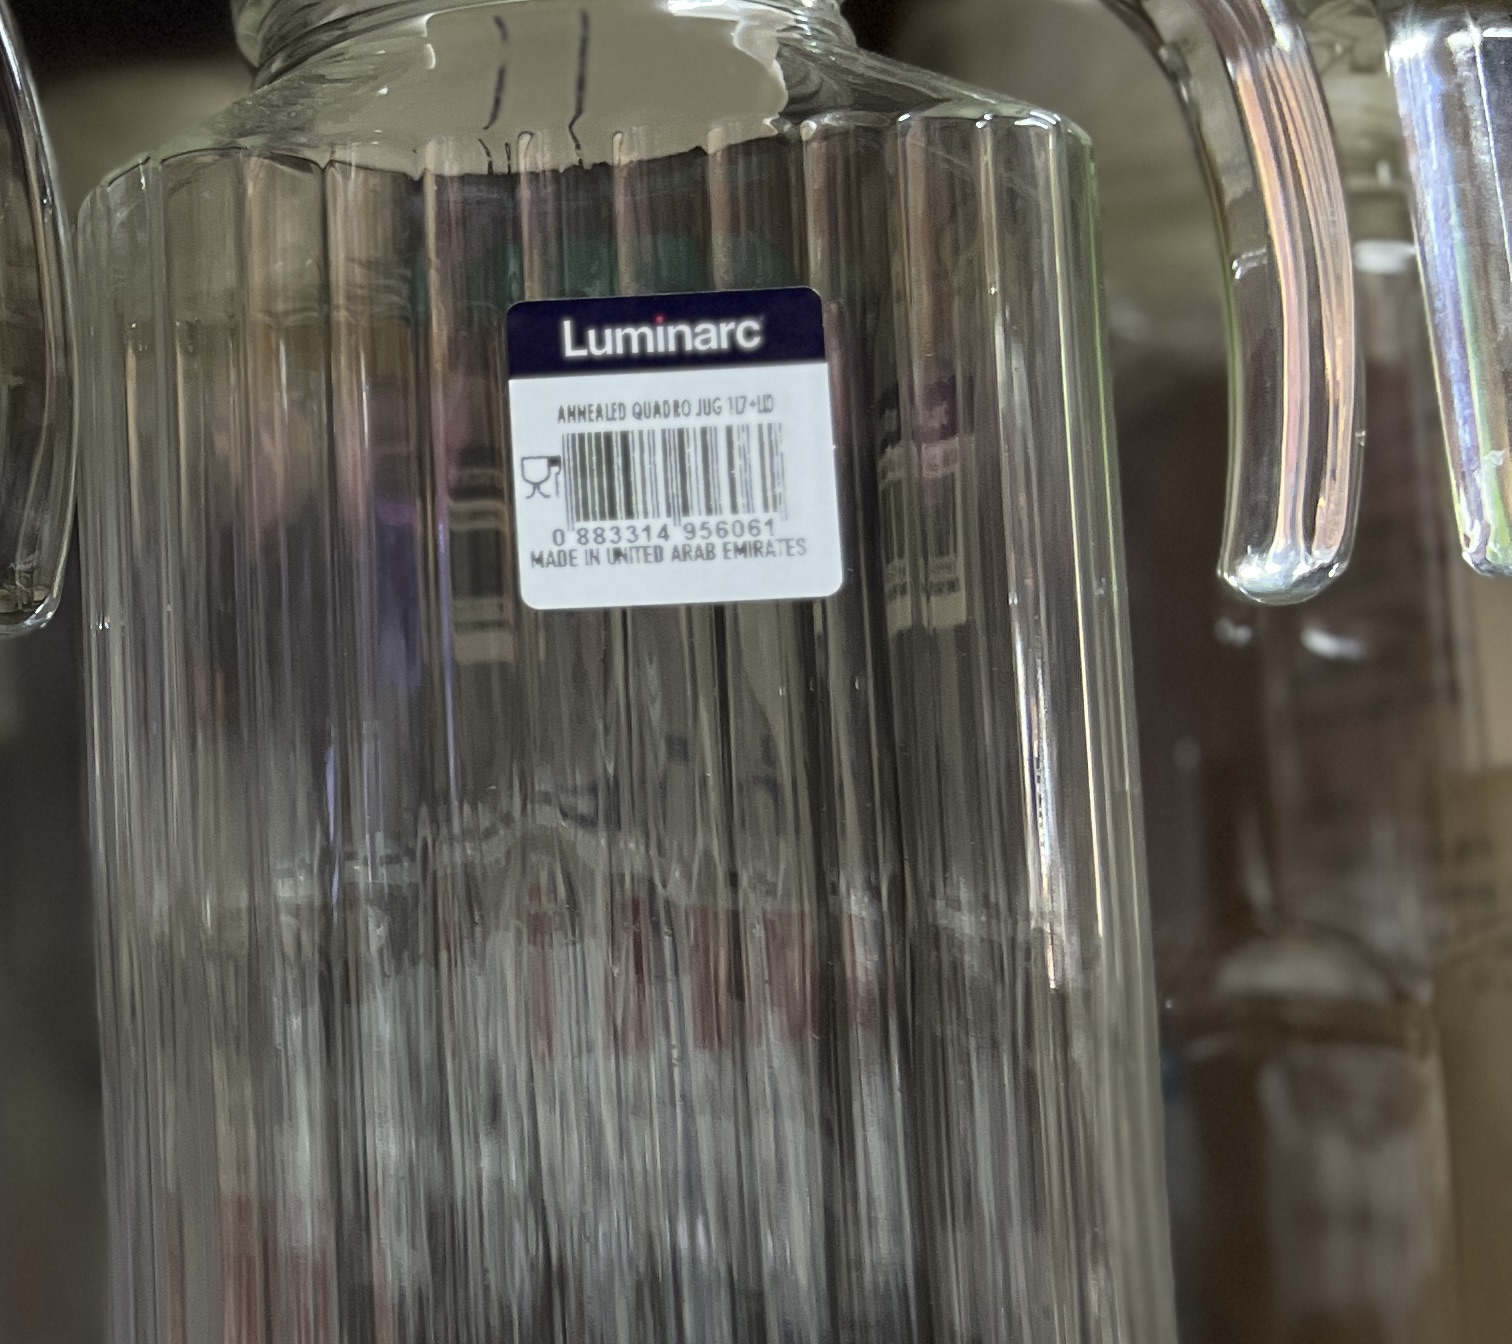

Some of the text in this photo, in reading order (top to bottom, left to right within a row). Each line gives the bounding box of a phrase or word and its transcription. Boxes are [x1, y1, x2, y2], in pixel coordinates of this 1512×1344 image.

[562, 314, 762, 358] Luminarc
[557, 401, 626, 423] ANNEALED
[631, 399, 692, 420] QUADRO
[695, 396, 723, 416] JUG
[552, 518, 776, 547] 0 883314 956061
[530, 537, 808, 568] MADE IN UNITED ARAB EMIRATES
